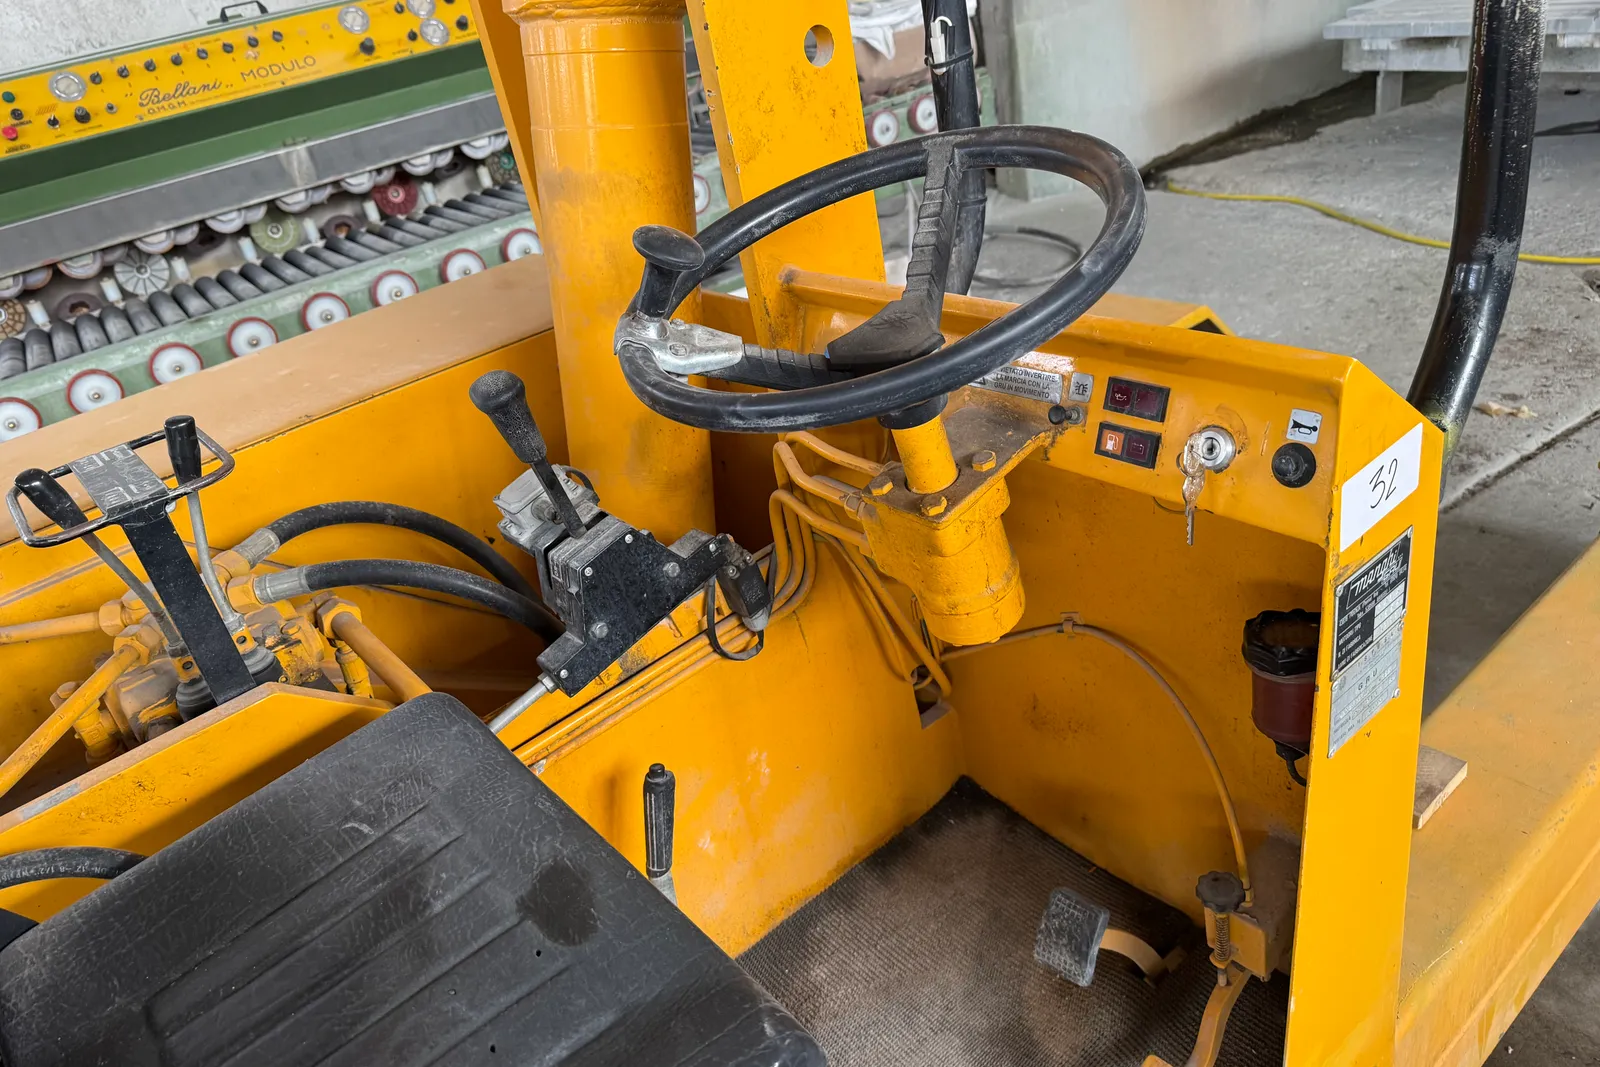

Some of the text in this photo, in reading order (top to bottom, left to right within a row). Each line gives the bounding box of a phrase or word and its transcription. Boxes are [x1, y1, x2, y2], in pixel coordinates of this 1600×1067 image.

[240, 55, 316, 82] MODULO
[138, 80, 223, 108] Bellani
[996, 373, 1050, 390] LA MARCIA CON LA
[1024, 370, 1056, 383] INVERTIRE
[1014, 385, 1050, 399] MOVIMENTO
[1369, 458, 1398, 509] 32
